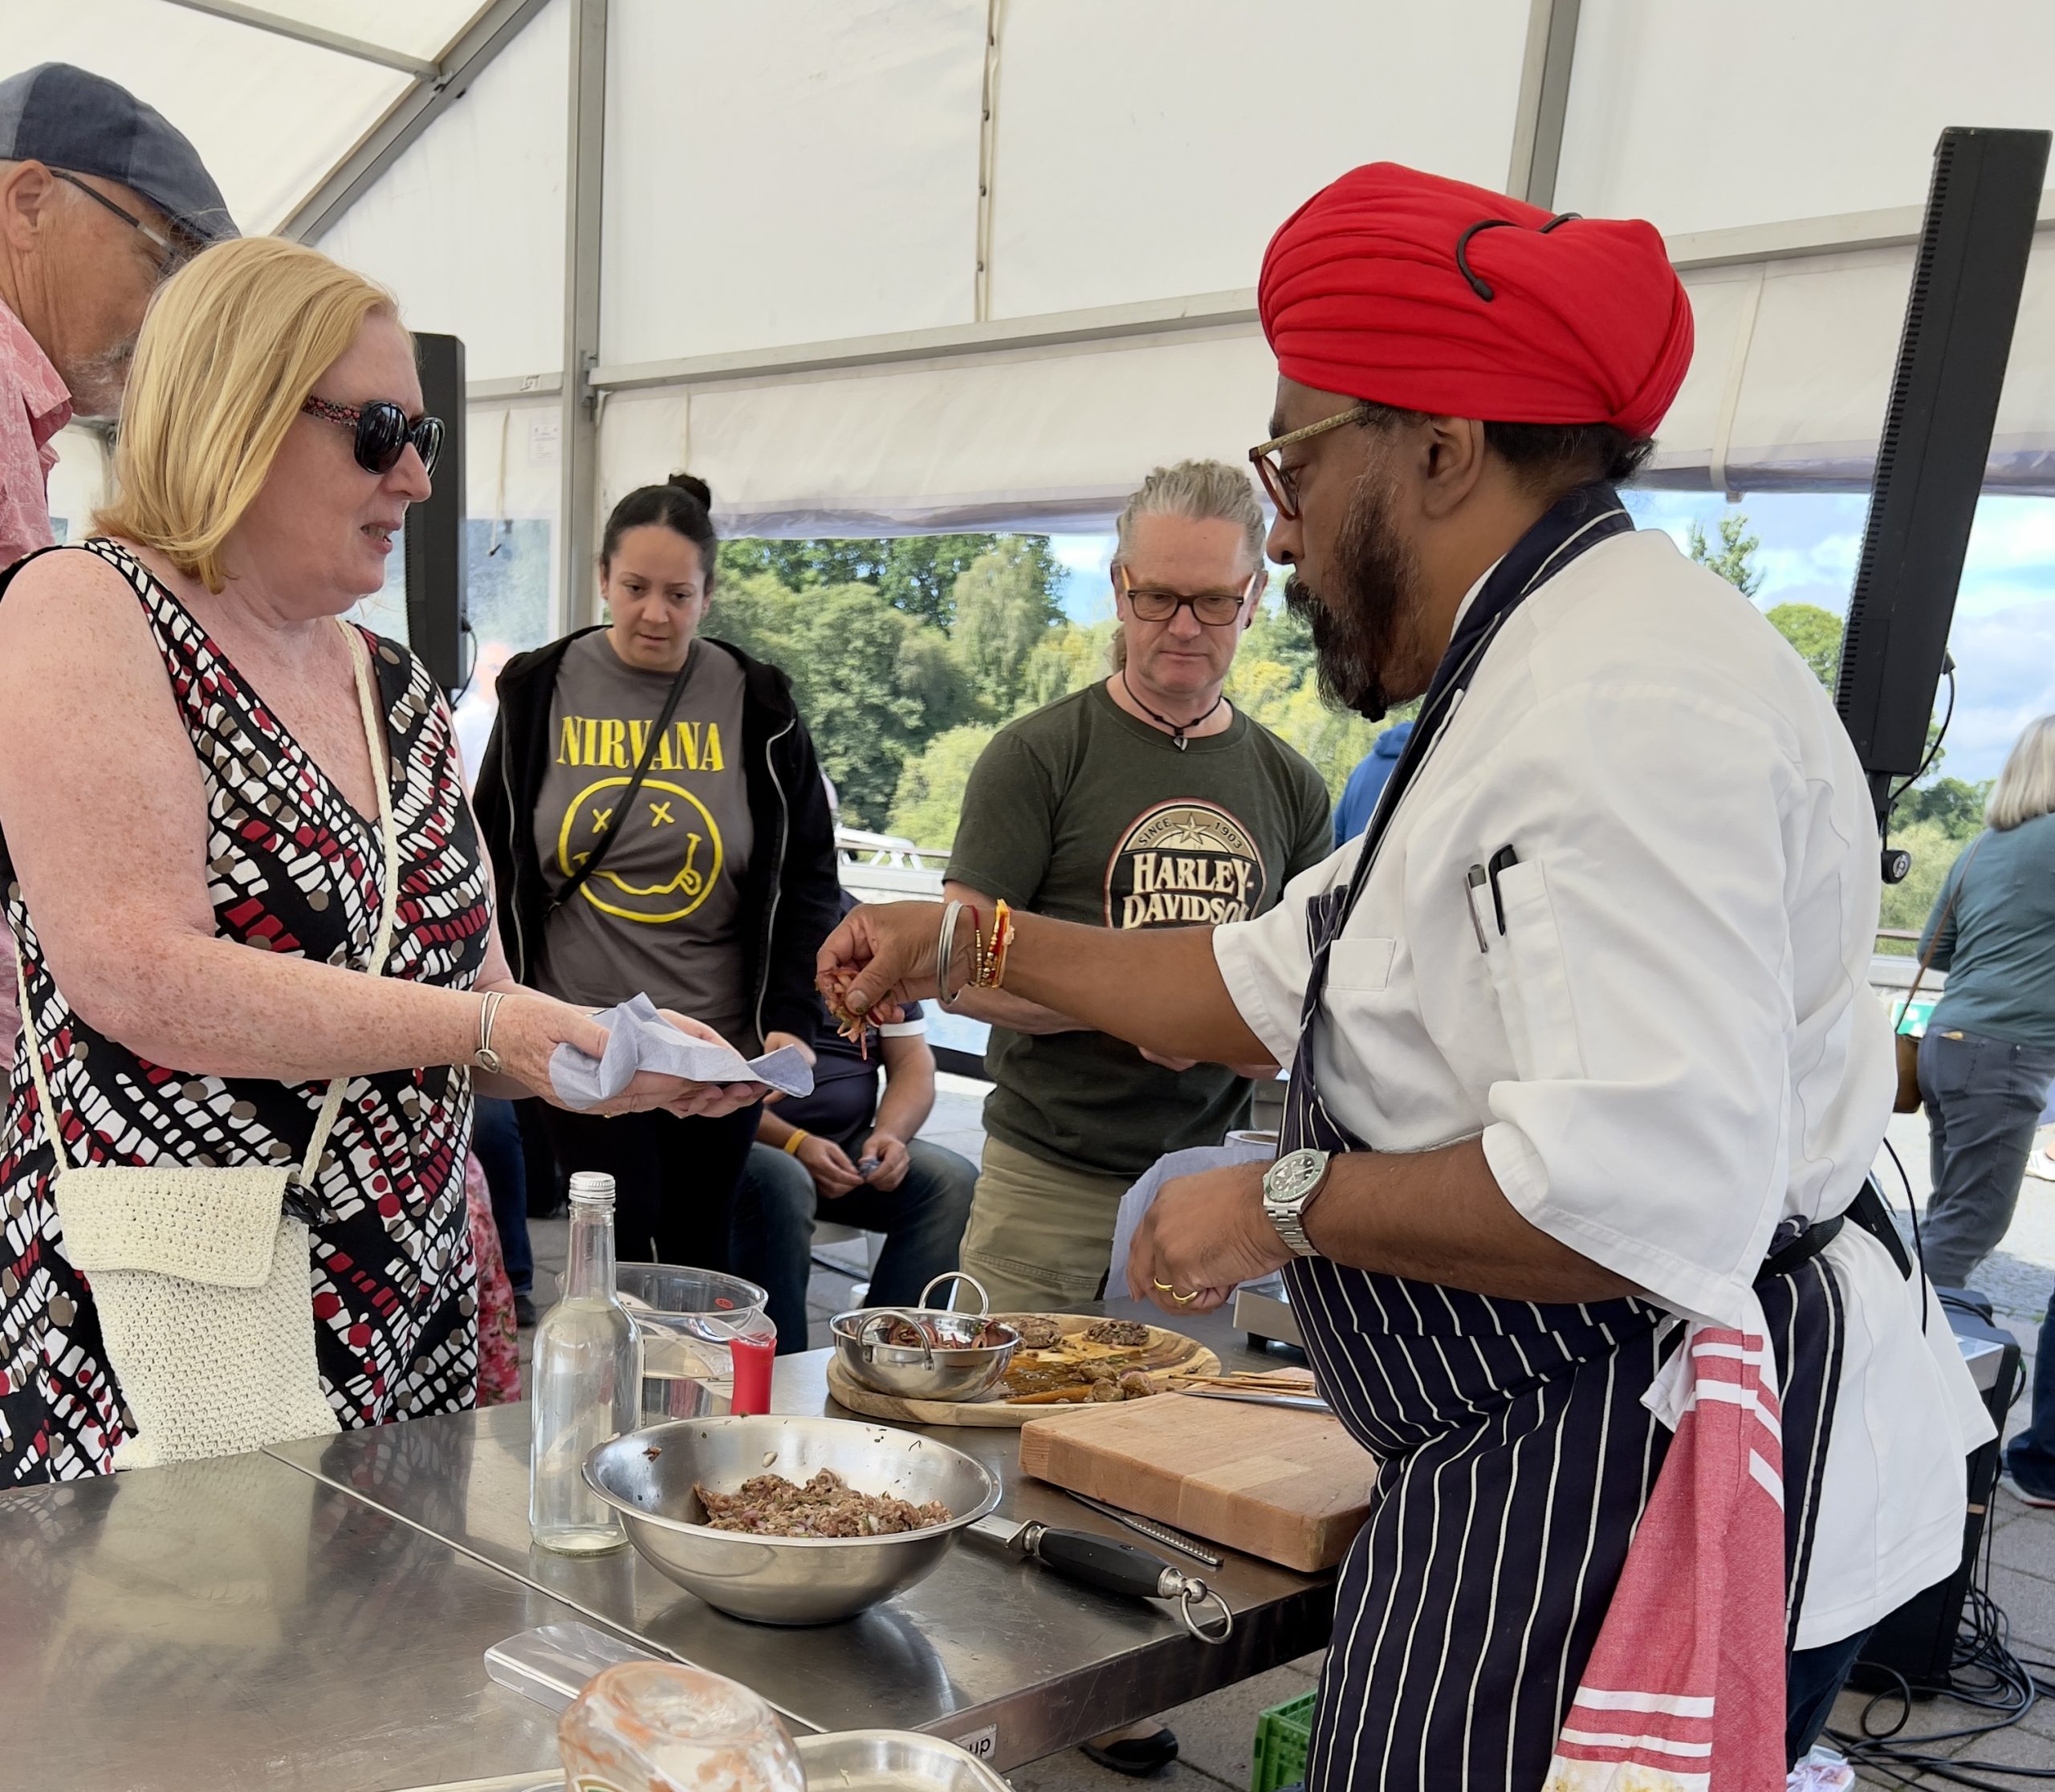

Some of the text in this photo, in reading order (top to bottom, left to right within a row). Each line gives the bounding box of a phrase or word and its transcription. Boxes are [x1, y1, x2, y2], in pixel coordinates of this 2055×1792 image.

[555, 715, 725, 772] NIRVANA
[1138, 818, 1243, 849] SINCE 1903
